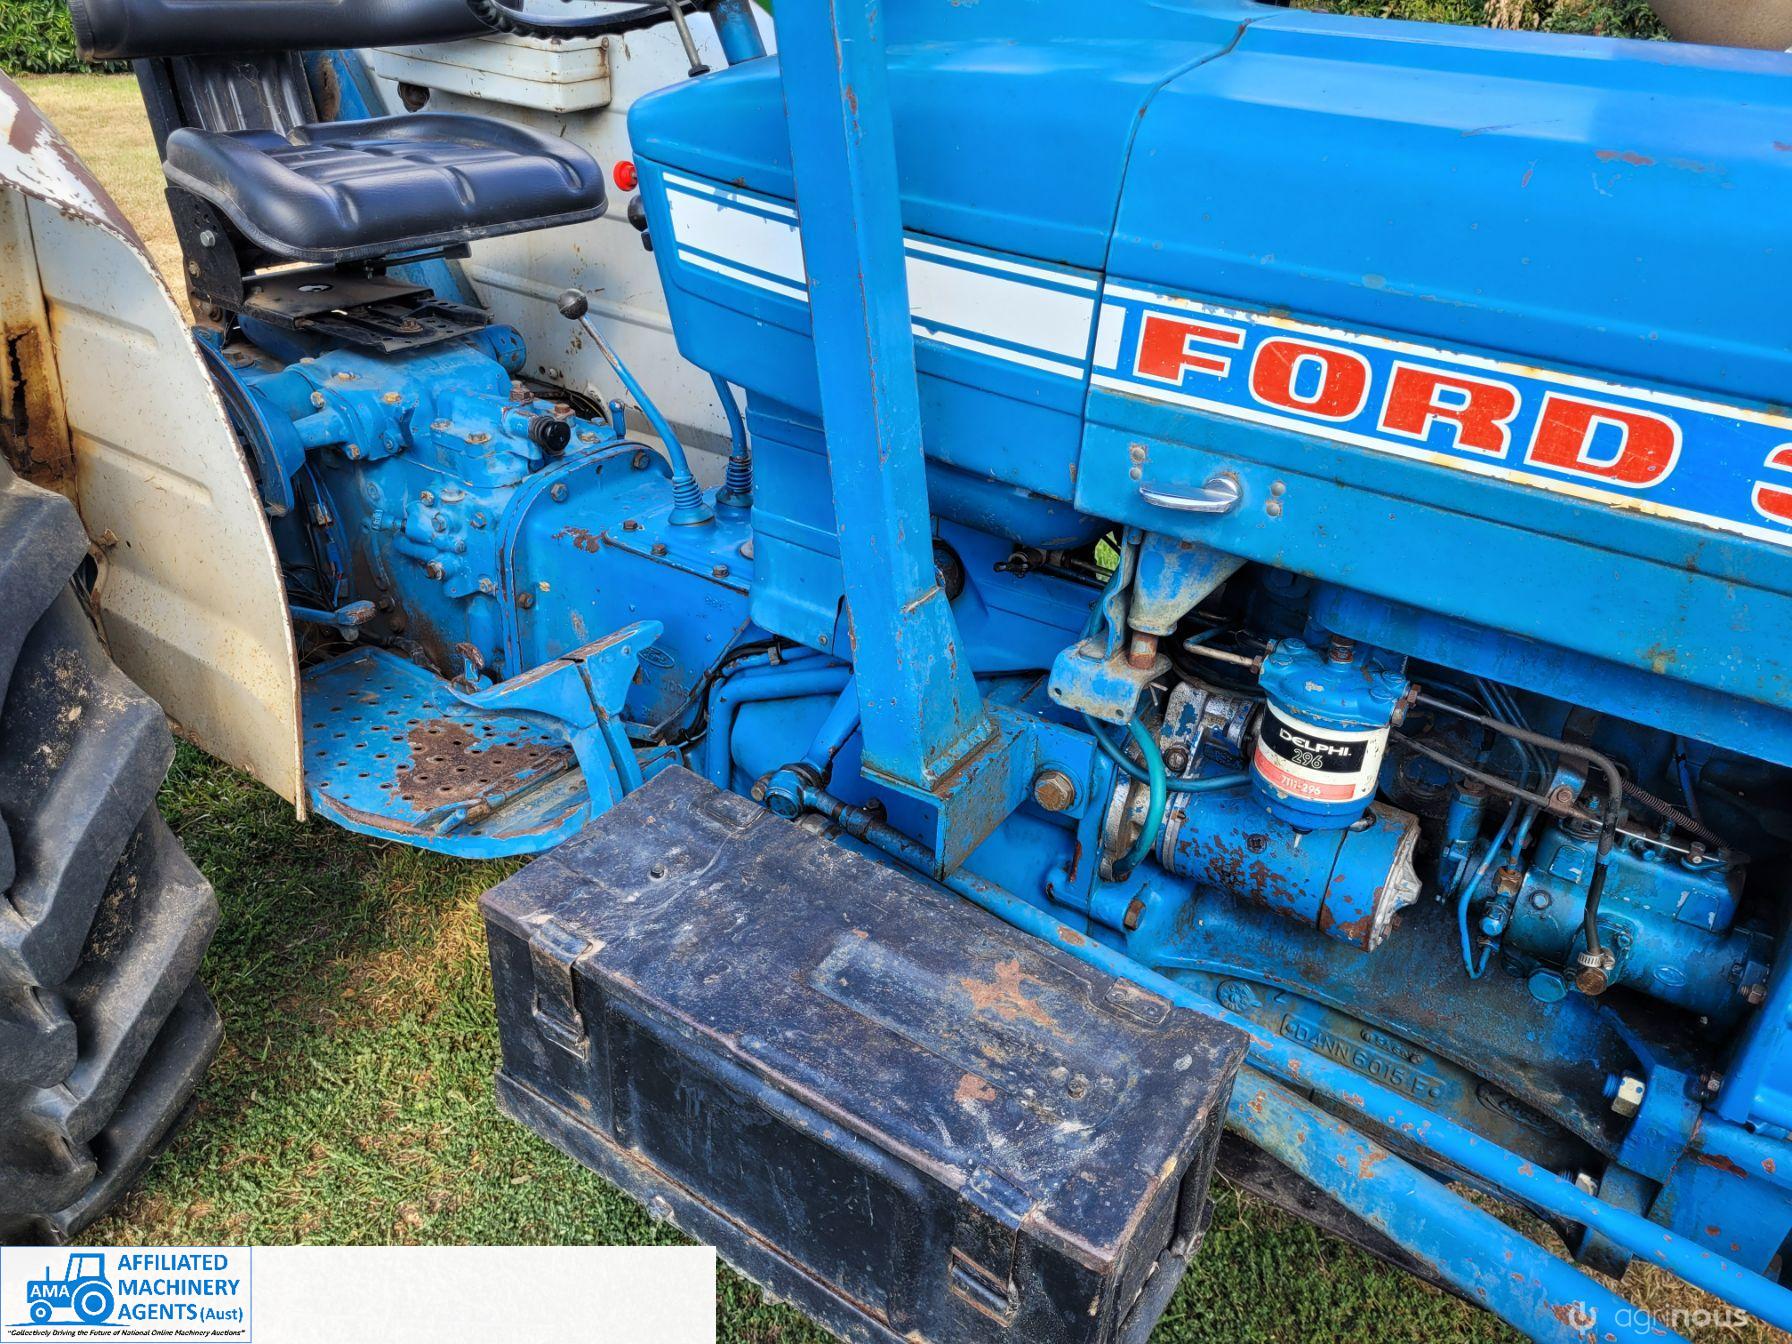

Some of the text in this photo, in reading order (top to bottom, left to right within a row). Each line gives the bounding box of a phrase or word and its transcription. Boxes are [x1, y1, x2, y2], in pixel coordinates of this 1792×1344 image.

[1133, 308, 1683, 489] FORD
[1292, 748, 1323, 769] 296
[1352, 1050, 1405, 1085] 6015
